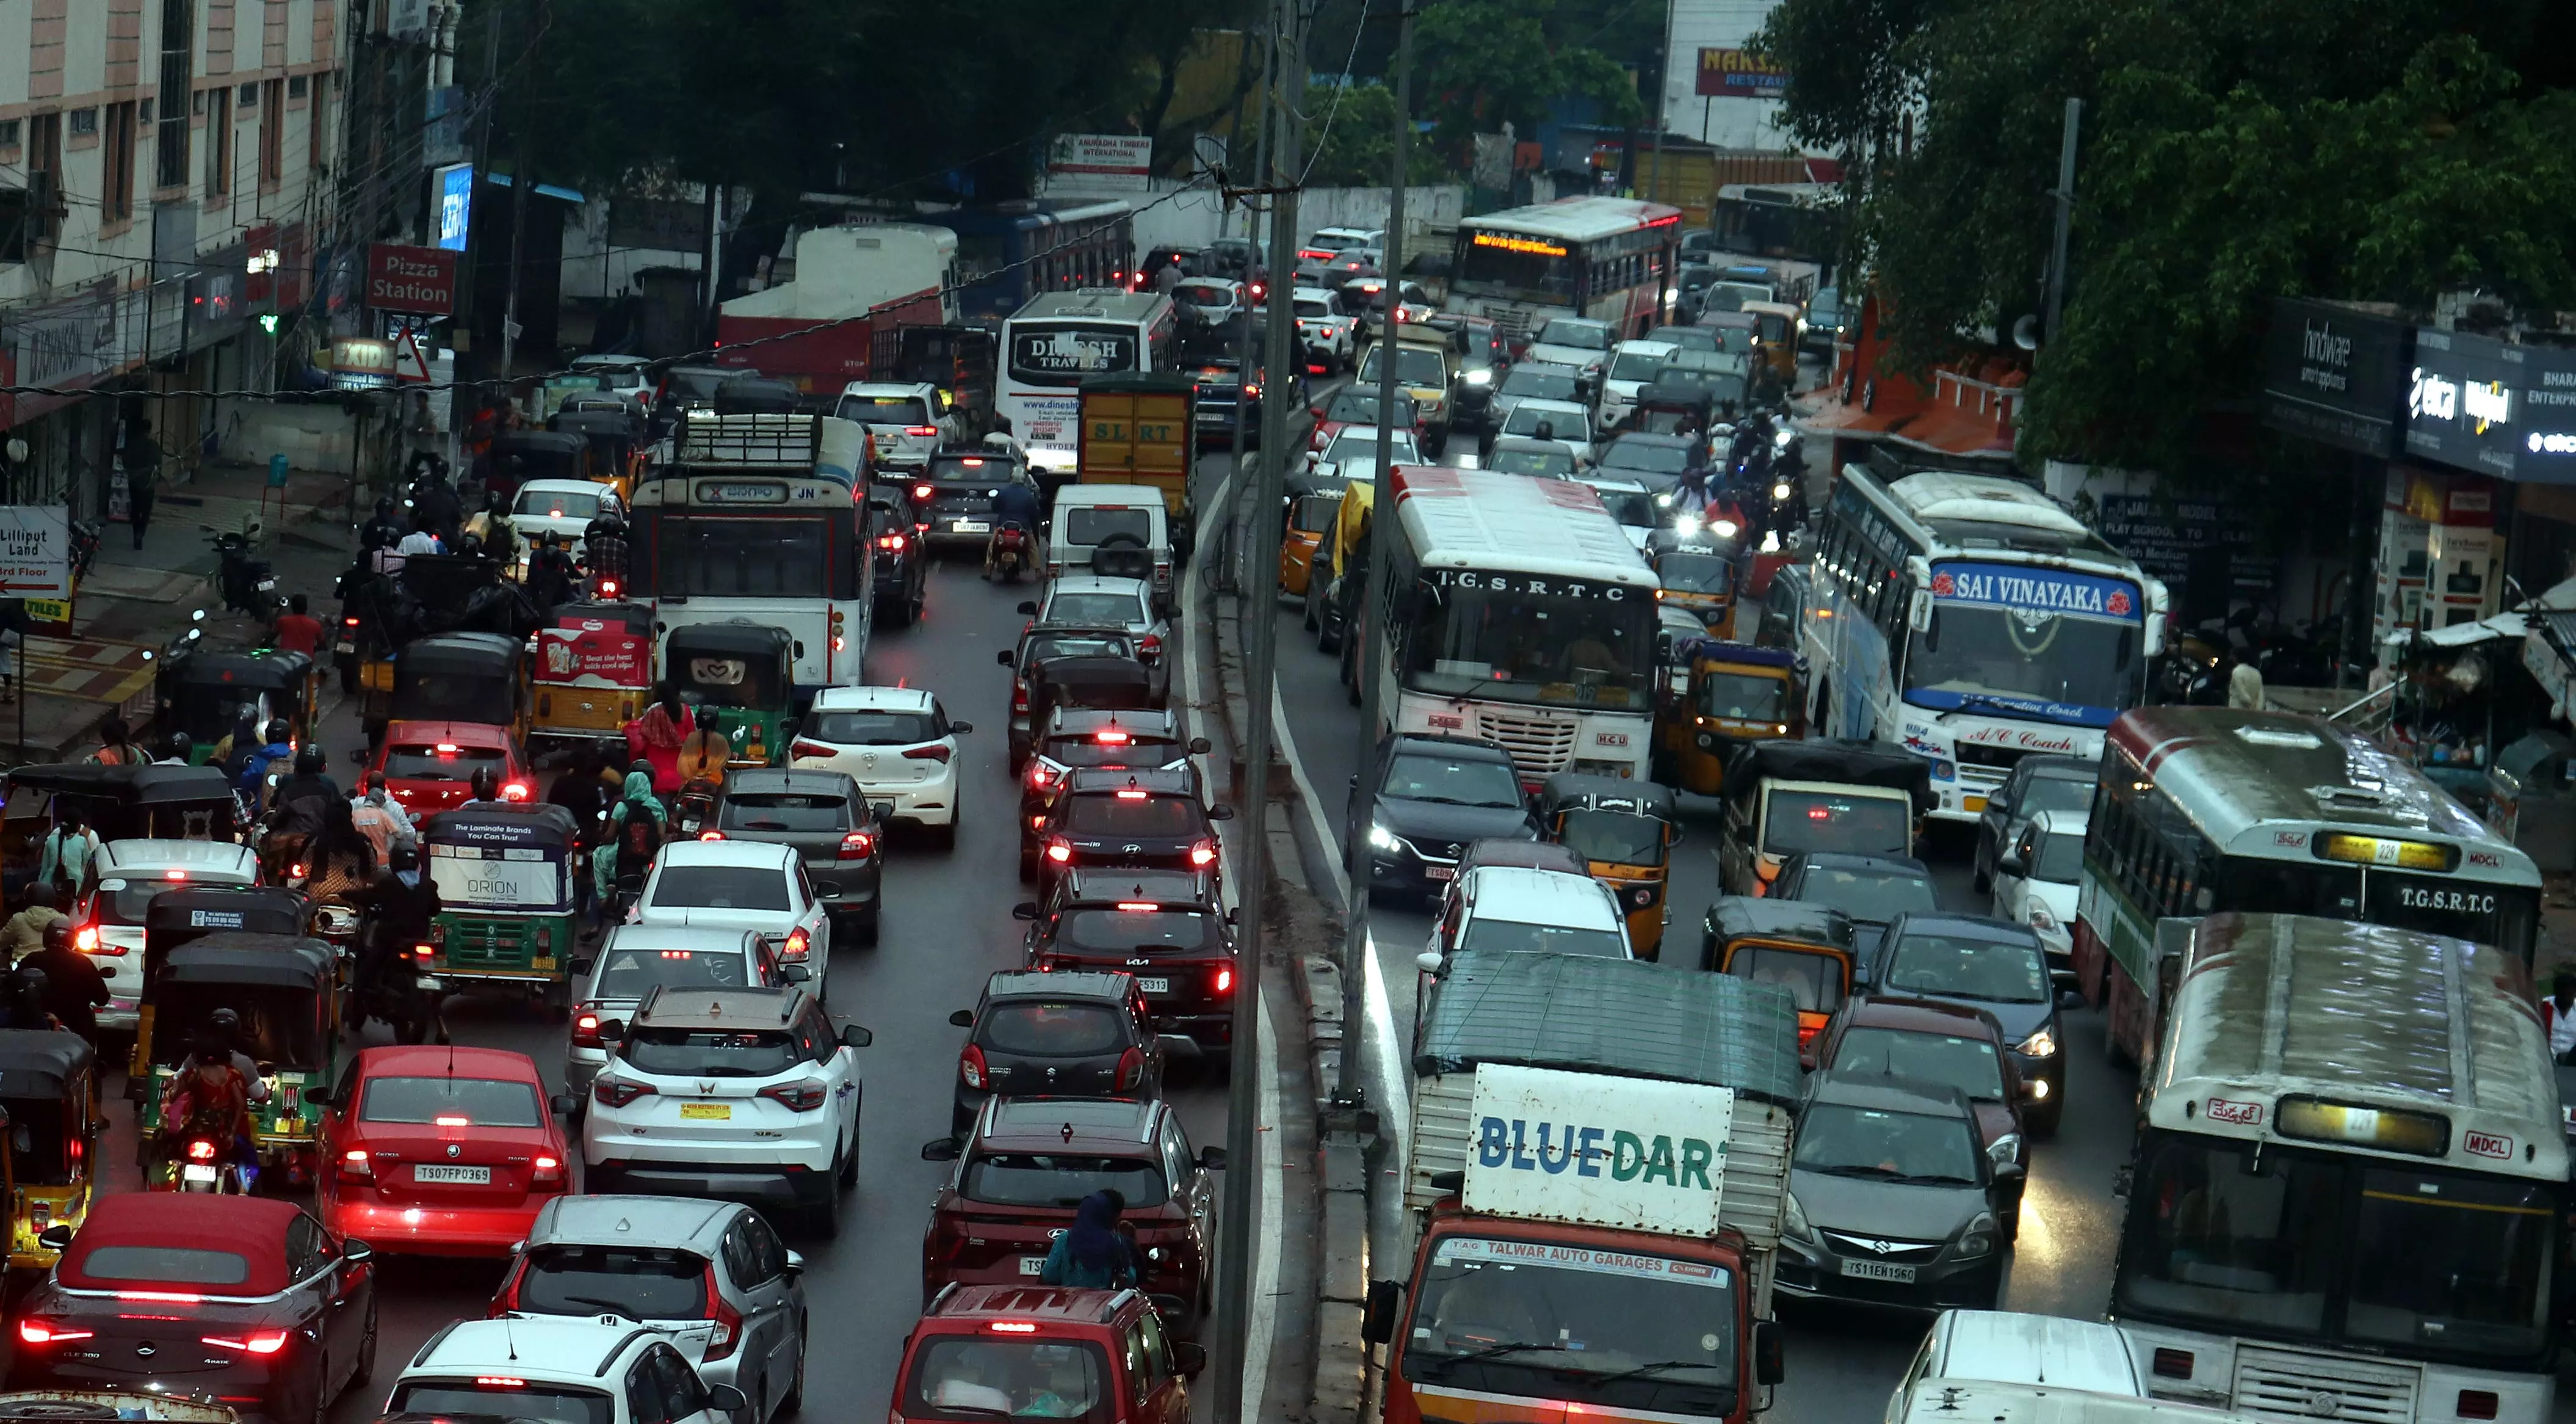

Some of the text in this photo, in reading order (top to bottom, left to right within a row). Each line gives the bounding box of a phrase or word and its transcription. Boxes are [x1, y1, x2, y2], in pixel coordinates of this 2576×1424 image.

[1079, 139, 1116, 147] ANURADHA
[386, 256, 439, 278] Pizza
[373, 278, 447, 304] Station
[333, 343, 395, 369] EXIDE
[798, 488, 814, 498] JN
[1, 529, 47, 545] Lilliput
[2105, 523, 2131, 536] PLAY
[2133, 524, 2177, 539] SCHOOL
[2186, 528, 2203, 540] TO
[10, 543, 38, 556] Land
[19, 567, 48, 576] Floor
[1956, 572, 2104, 612] SAI VINAYAKA
[2046, 703, 2083, 719] Coach
[2019, 730, 2071, 750] Coach
[469, 824, 504, 834] Laminate
[506, 826, 532, 835] Brands
[2469, 854, 2500, 867] MDCL
[468, 879, 517, 894] ORION
[2401, 887, 2495, 914] T.G.S.R.T.C
[2470, 1135, 2505, 1155] MDCL
[421, 1168, 488, 1180] TS07FP0369
[1488, 1242, 1546, 1259] TALWAR
[1549, 1246, 1590, 1263] AUTO
[1594, 1252, 1663, 1271] GARAGES
